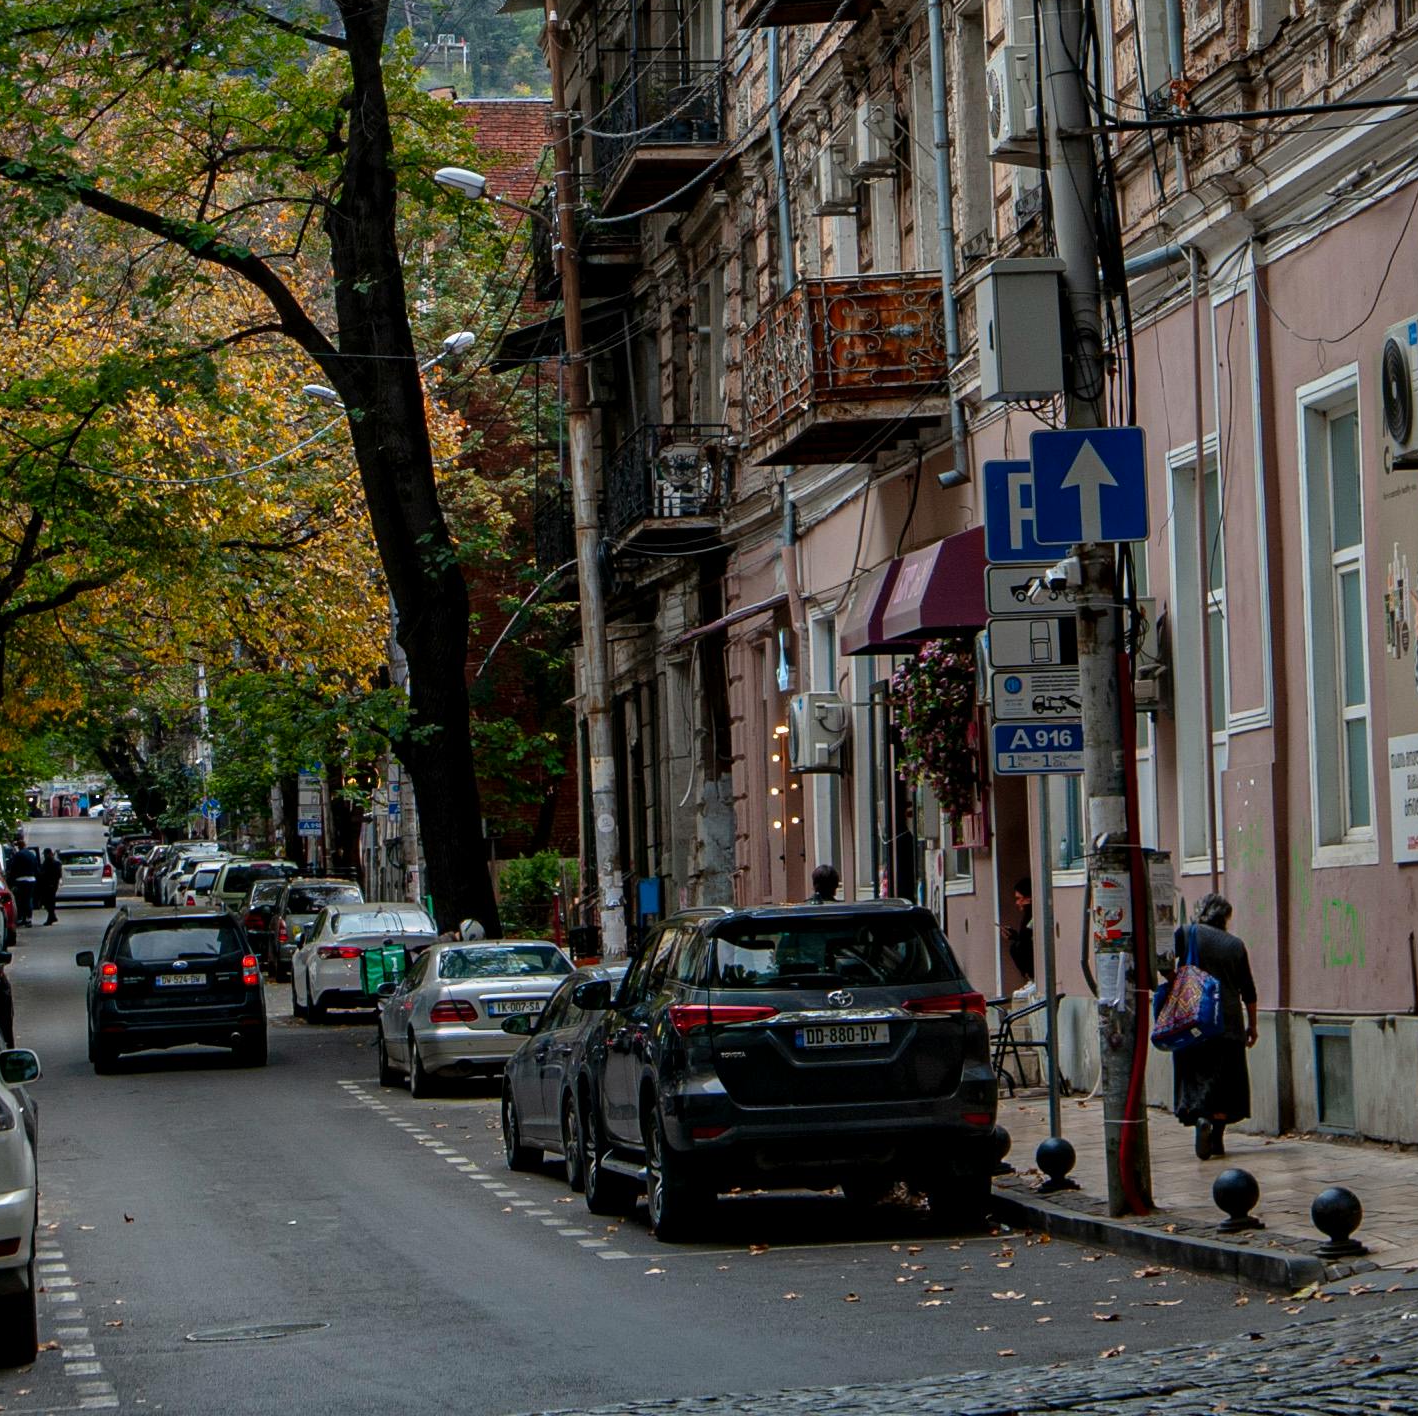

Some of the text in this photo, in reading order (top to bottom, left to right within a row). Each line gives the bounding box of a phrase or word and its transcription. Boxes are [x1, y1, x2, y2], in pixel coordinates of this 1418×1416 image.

[1009, 728, 1073, 750] A 916
[1007, 755, 1017, 768] 1
[1042, 754, 1052, 768] 1
[806, 1026, 878, 1044] DD-880-DY
